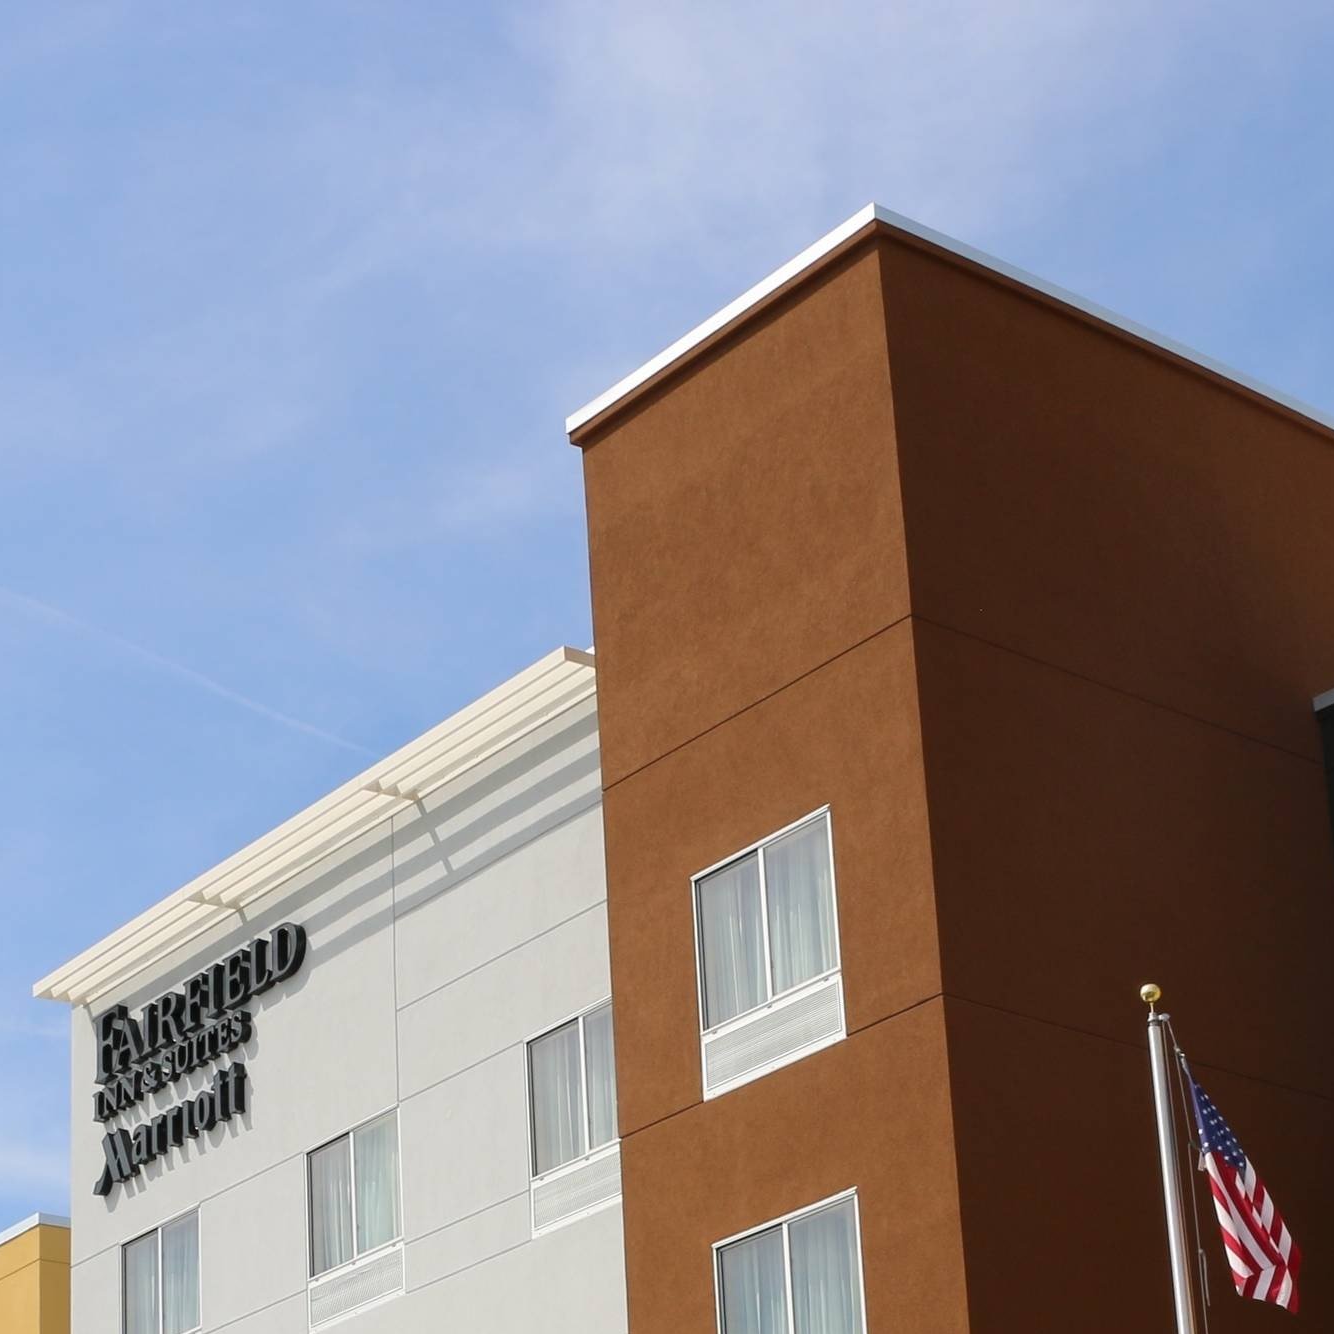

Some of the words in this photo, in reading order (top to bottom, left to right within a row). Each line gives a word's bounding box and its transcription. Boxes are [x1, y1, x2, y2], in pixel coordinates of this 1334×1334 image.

[93, 922, 307, 1085] FAIRFIELD
[93, 1070, 144, 1123] INN
[141, 1061, 167, 1094] &
[161, 1010, 252, 1083] SUITES
[93, 1062, 247, 1196] Marriott
